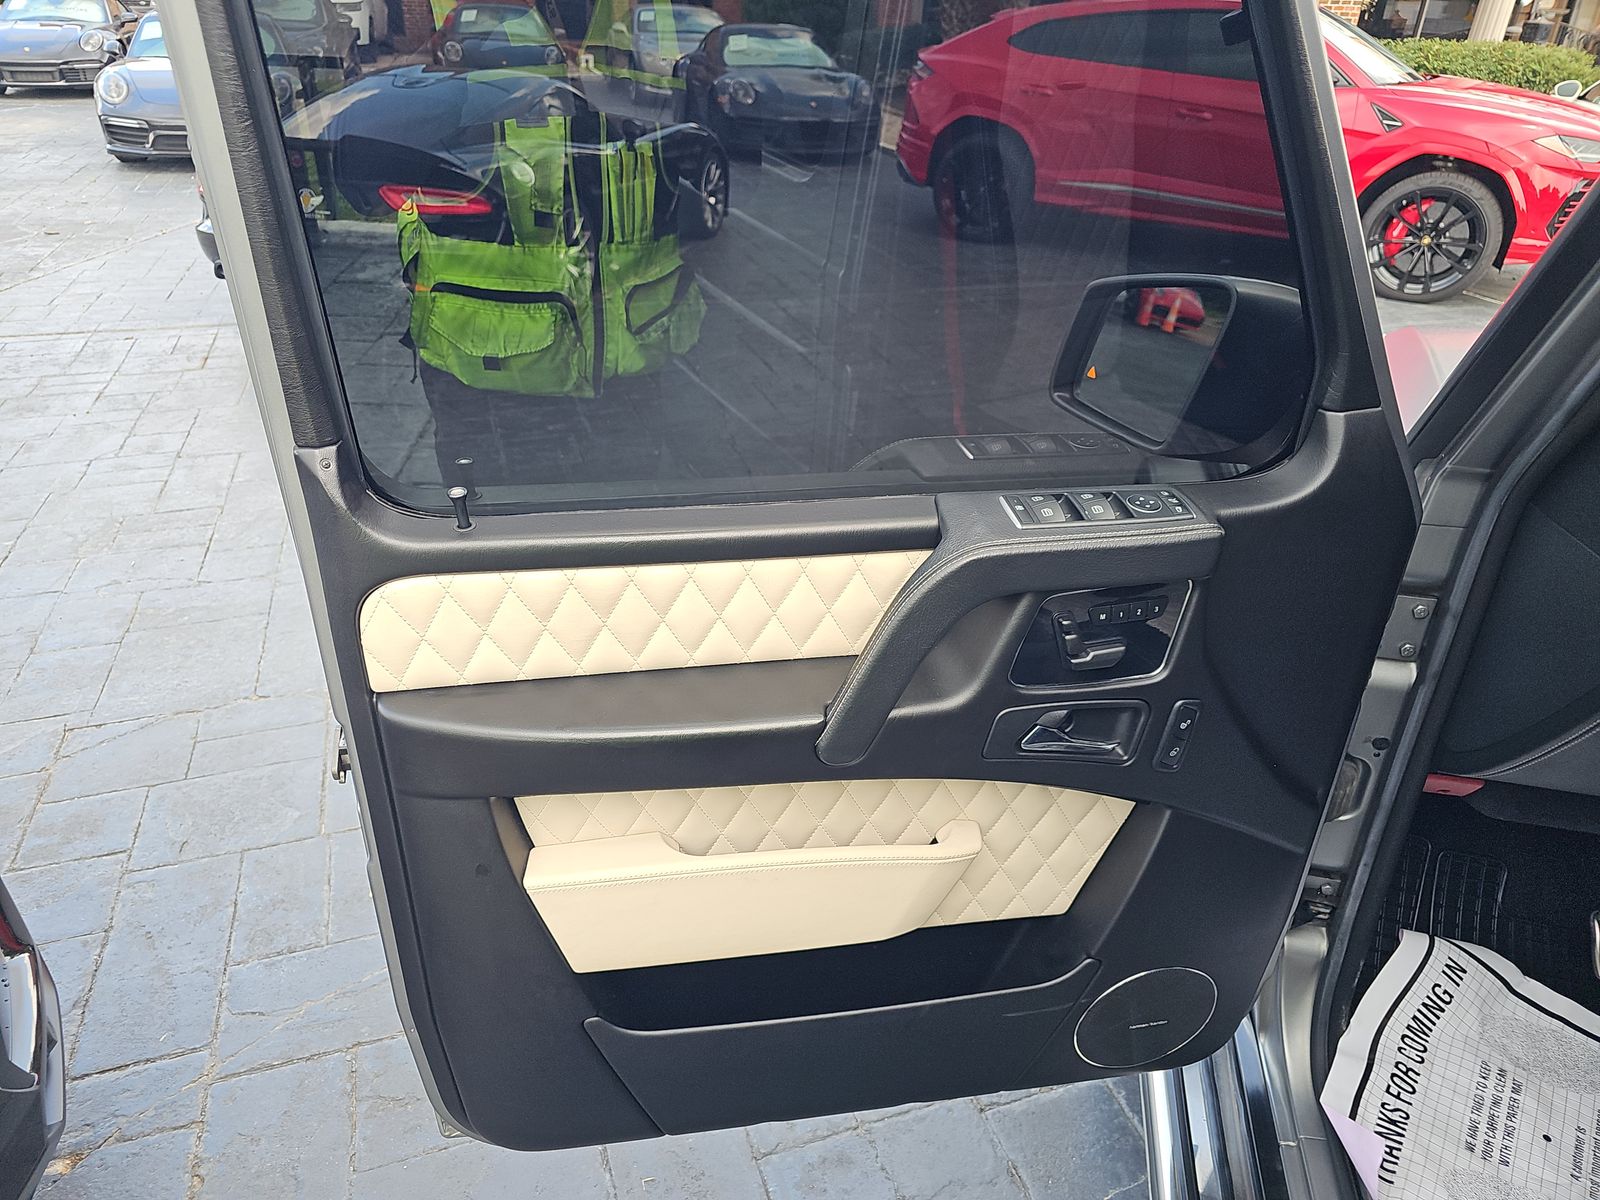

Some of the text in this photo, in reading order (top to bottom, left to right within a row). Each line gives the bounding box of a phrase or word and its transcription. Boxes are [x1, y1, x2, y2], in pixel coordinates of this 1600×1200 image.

[1136, 608, 1142, 616] 2
[1441, 956, 1468, 988] IN
[1397, 983, 1454, 1065] COMING
[1385, 1061, 1421, 1106] FOR
[1464, 1060, 1492, 1154] WE HAVE TRIED TO KEEP
[1480, 1067, 1507, 1163] YOUR CARPETING CLEAN
[1498, 1077, 1523, 1168] WITH THIS PAPER MAT
[1570, 1173, 1581, 1182] A
[1572, 1135, 1585, 1175] customer
